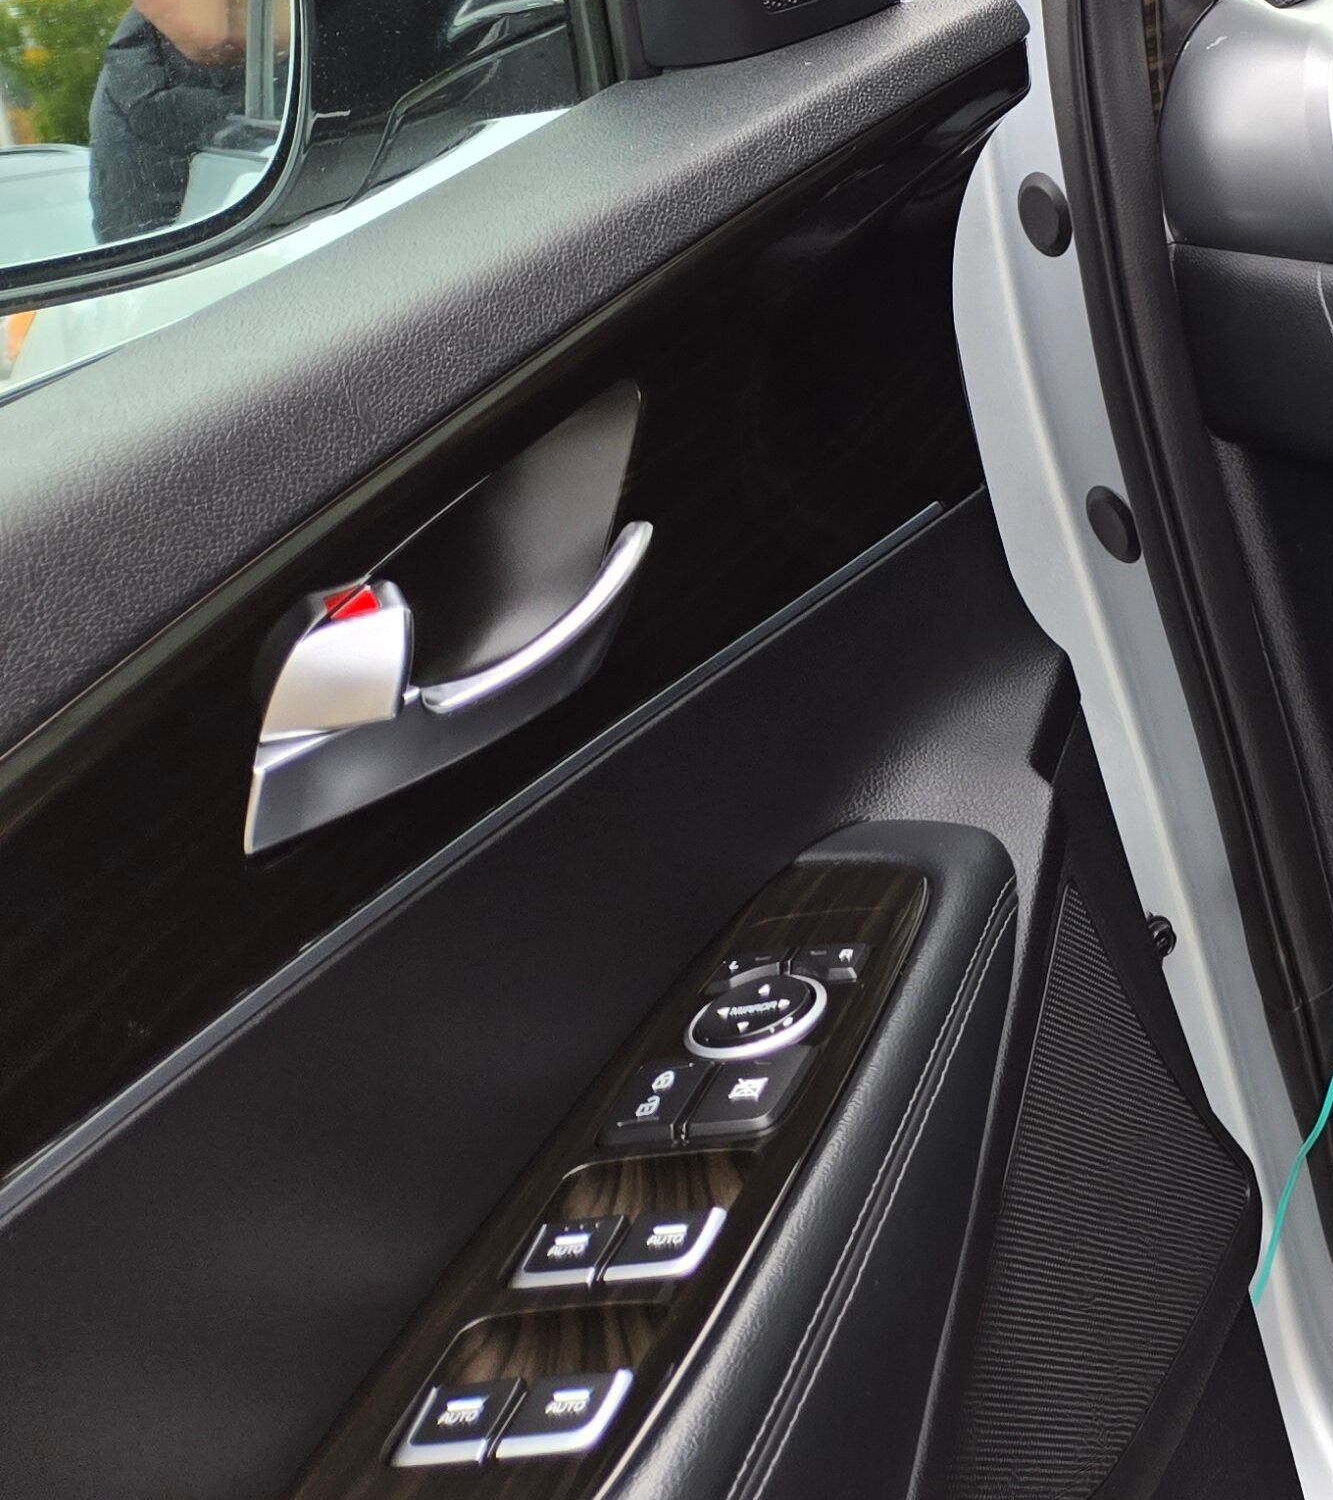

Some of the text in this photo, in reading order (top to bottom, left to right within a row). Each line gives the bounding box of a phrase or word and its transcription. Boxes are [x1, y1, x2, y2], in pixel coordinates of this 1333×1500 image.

[730, 1000, 778, 1017] MIRROR
[646, 1233, 684, 1247] AUTO
[547, 1244, 585, 1258] AUTO
[545, 1400, 585, 1414] AUTO
[437, 1410, 478, 1426] AUTO
